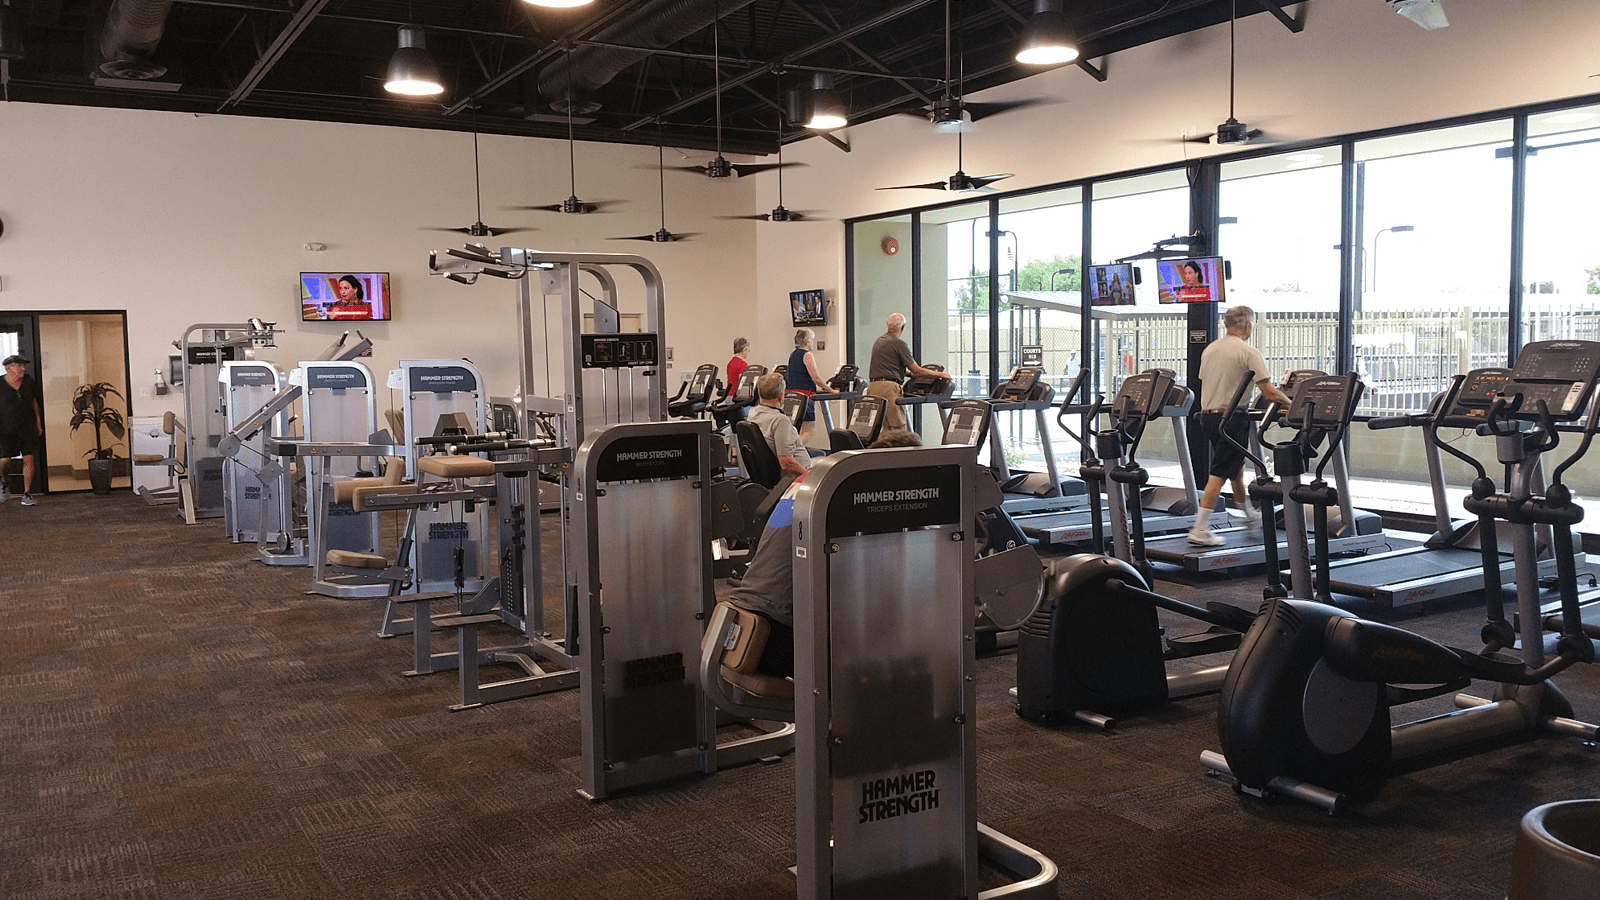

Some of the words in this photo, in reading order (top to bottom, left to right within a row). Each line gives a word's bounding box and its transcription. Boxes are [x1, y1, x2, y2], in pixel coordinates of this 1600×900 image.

[616, 452, 648, 462] HAMMER
[649, 450, 682, 459] STRENGTH
[854, 490, 894, 505] HAMMER
[896, 488, 939, 500] STRENGTH
[867, 505, 892, 513] TRICEPS
[894, 503, 928, 511] EXTENSION
[430, 522, 467, 531] HAMMER
[429, 530, 468, 539] STRENGTH
[862, 770, 936, 804] HAMMER
[859, 788, 940, 824] STRENGTH
